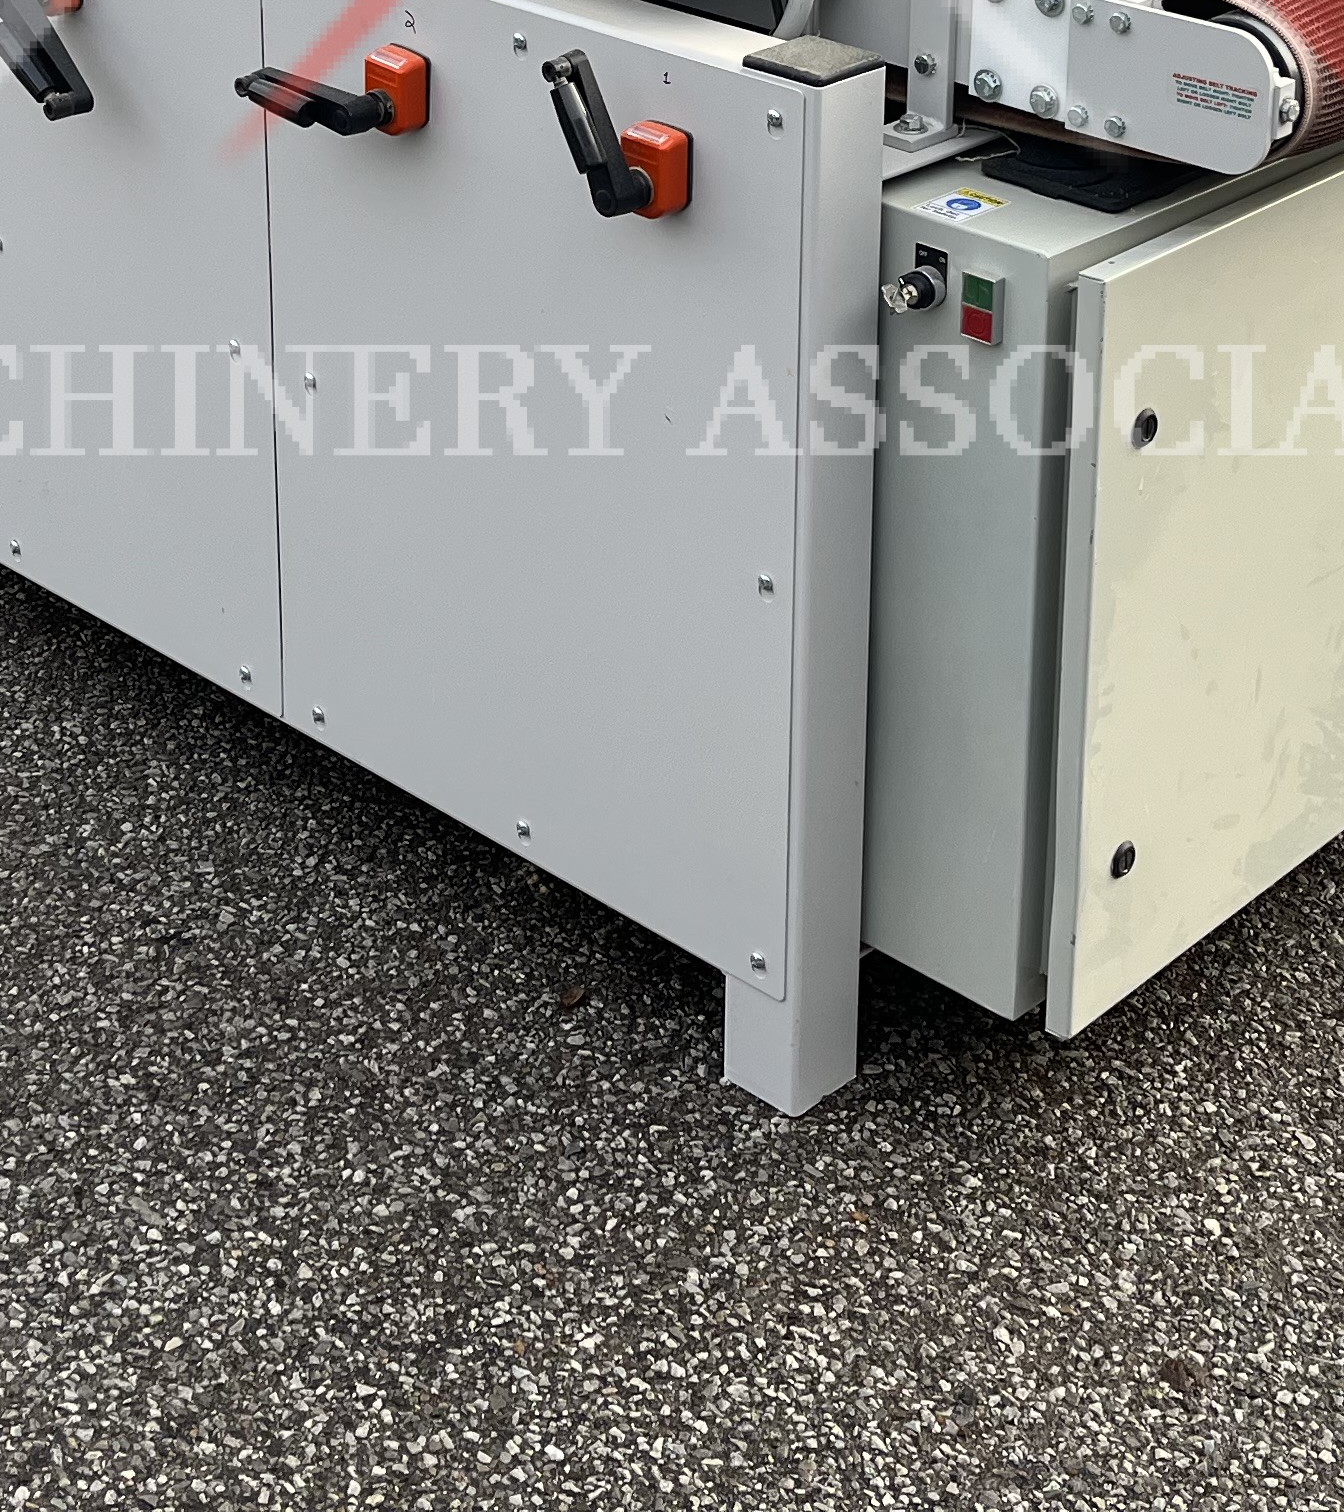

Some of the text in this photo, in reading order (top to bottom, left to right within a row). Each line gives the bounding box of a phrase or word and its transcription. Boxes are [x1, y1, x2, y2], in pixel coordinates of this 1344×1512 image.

[404, 9, 416, 34] 2
[663, 71, 671, 84] 1
[1173, 73, 1207, 85] ADJUSTING
[1225, 85, 1257, 97] TRACKING
